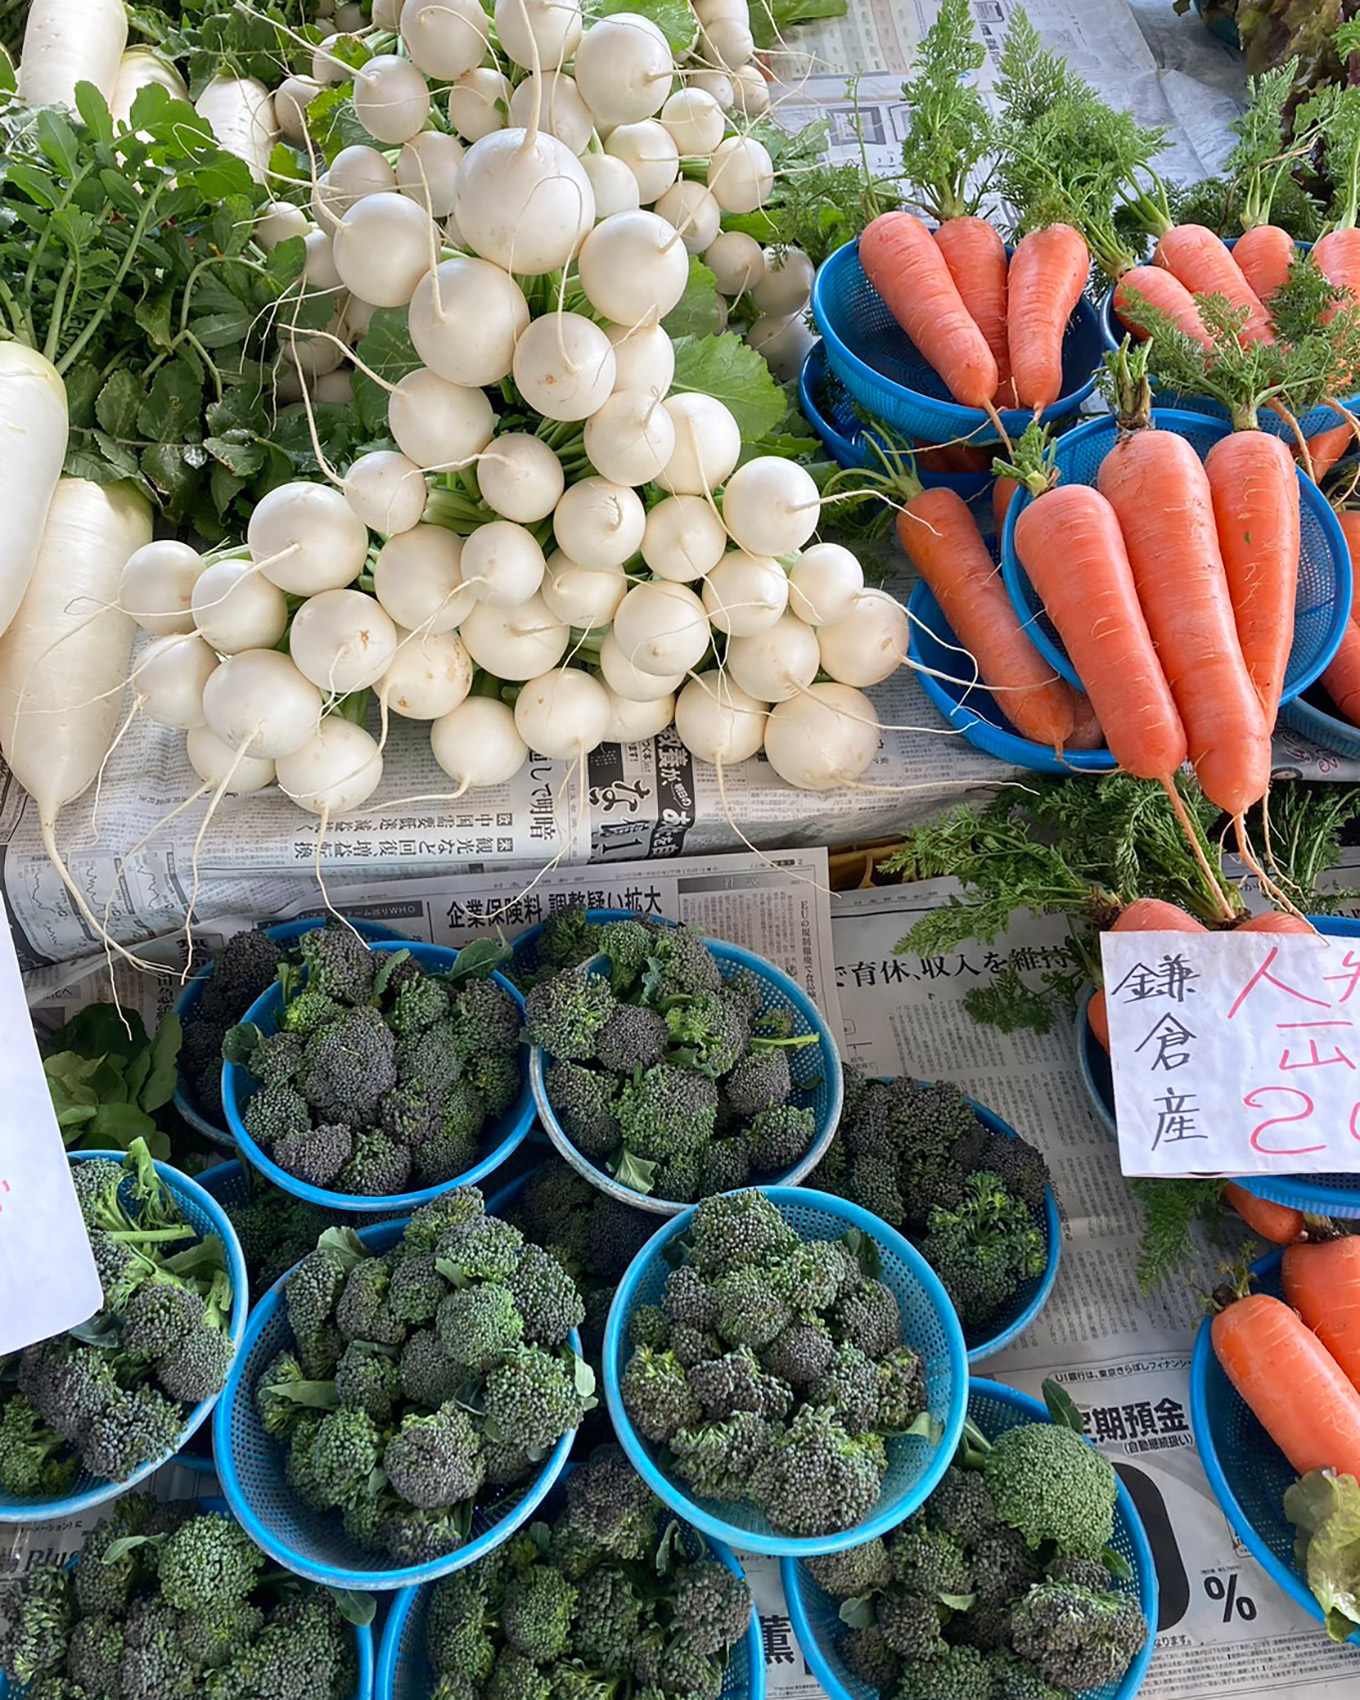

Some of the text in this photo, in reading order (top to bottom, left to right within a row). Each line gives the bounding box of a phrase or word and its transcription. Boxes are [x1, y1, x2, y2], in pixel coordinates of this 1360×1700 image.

[446, 893, 543, 929] 企業保険料
[1111, 953, 1208, 1151] 鎌倉産
[1243, 1086, 1360, 1154] 2
[1203, 1574, 1257, 1623] %
